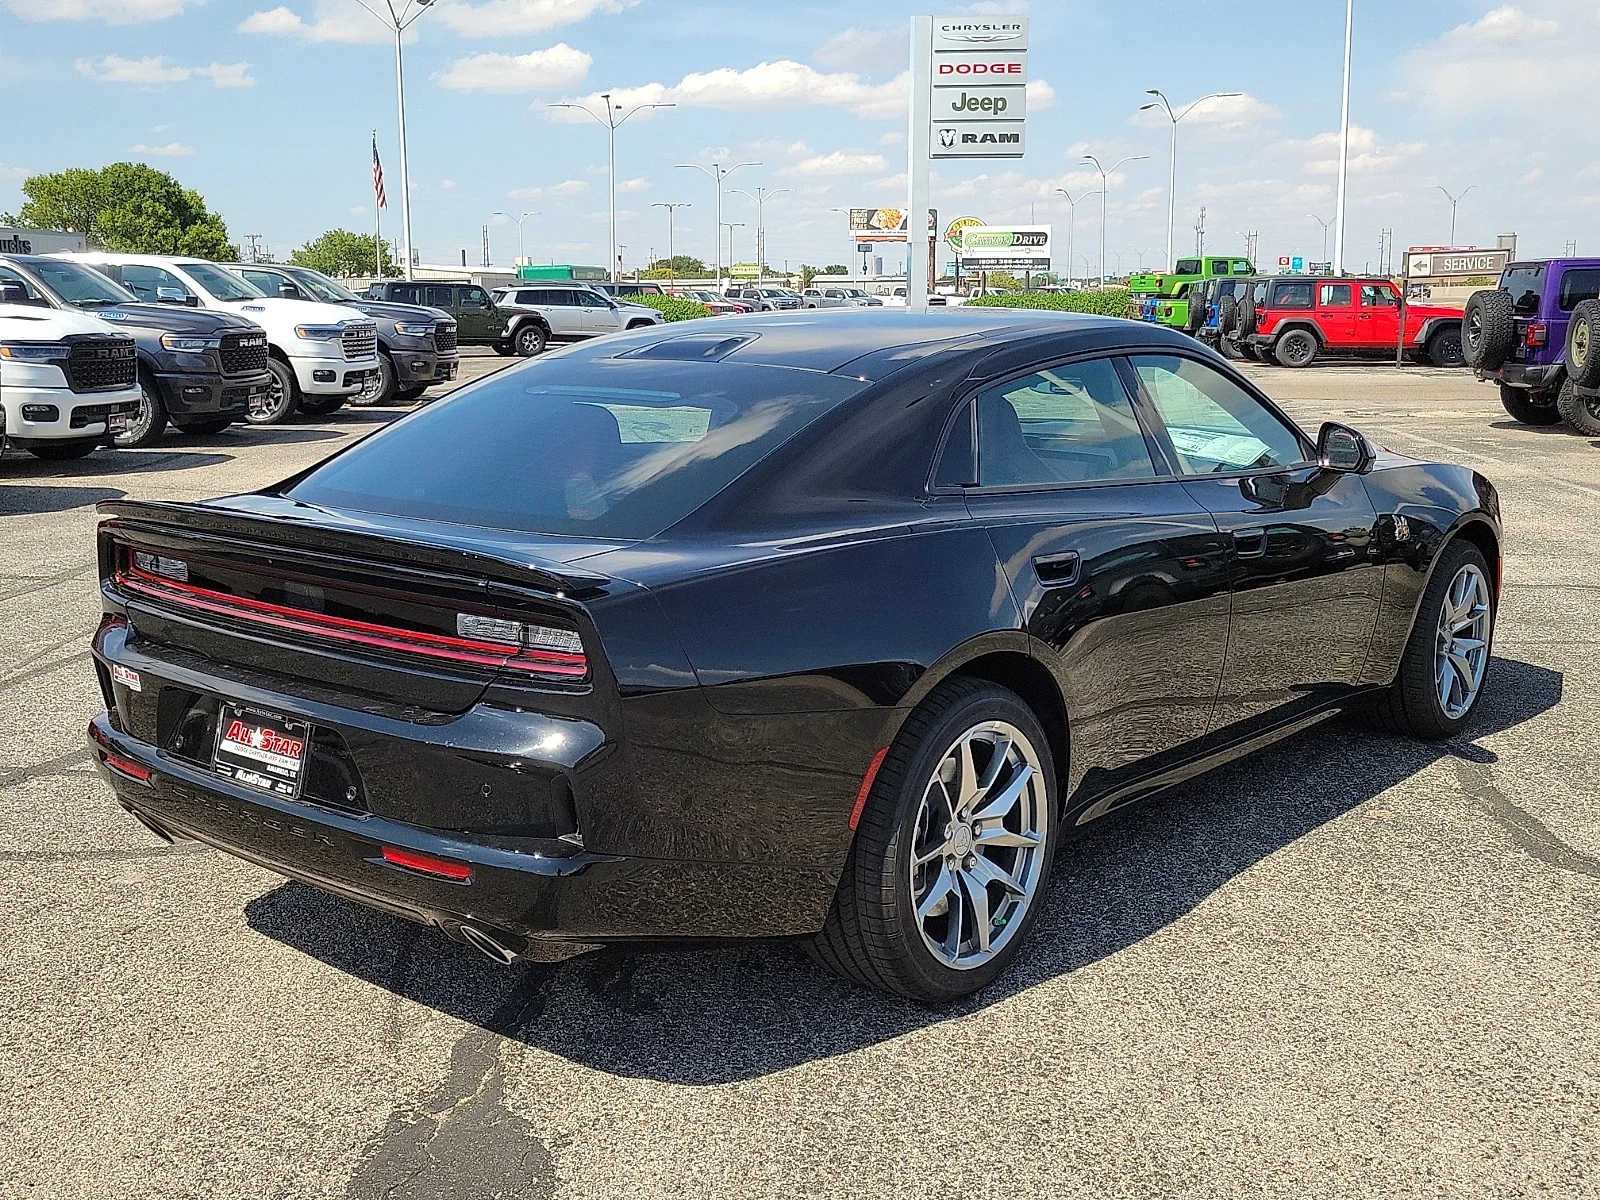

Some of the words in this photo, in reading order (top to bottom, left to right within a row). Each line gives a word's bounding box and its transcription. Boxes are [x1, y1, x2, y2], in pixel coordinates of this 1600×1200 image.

[941, 24, 1021, 32] CHRYSLER
[939, 63, 1022, 74] DODGE
[951, 92, 1008, 116] Jeep
[961, 133, 1020, 144] RAM
[1012, 233, 1046, 246] DRIVE
[1443, 256, 1495, 271] SERVICE
[239, 338, 263, 347] RAM
[97, 348, 129, 359] RAM
[260, 728, 303, 758] STAR
